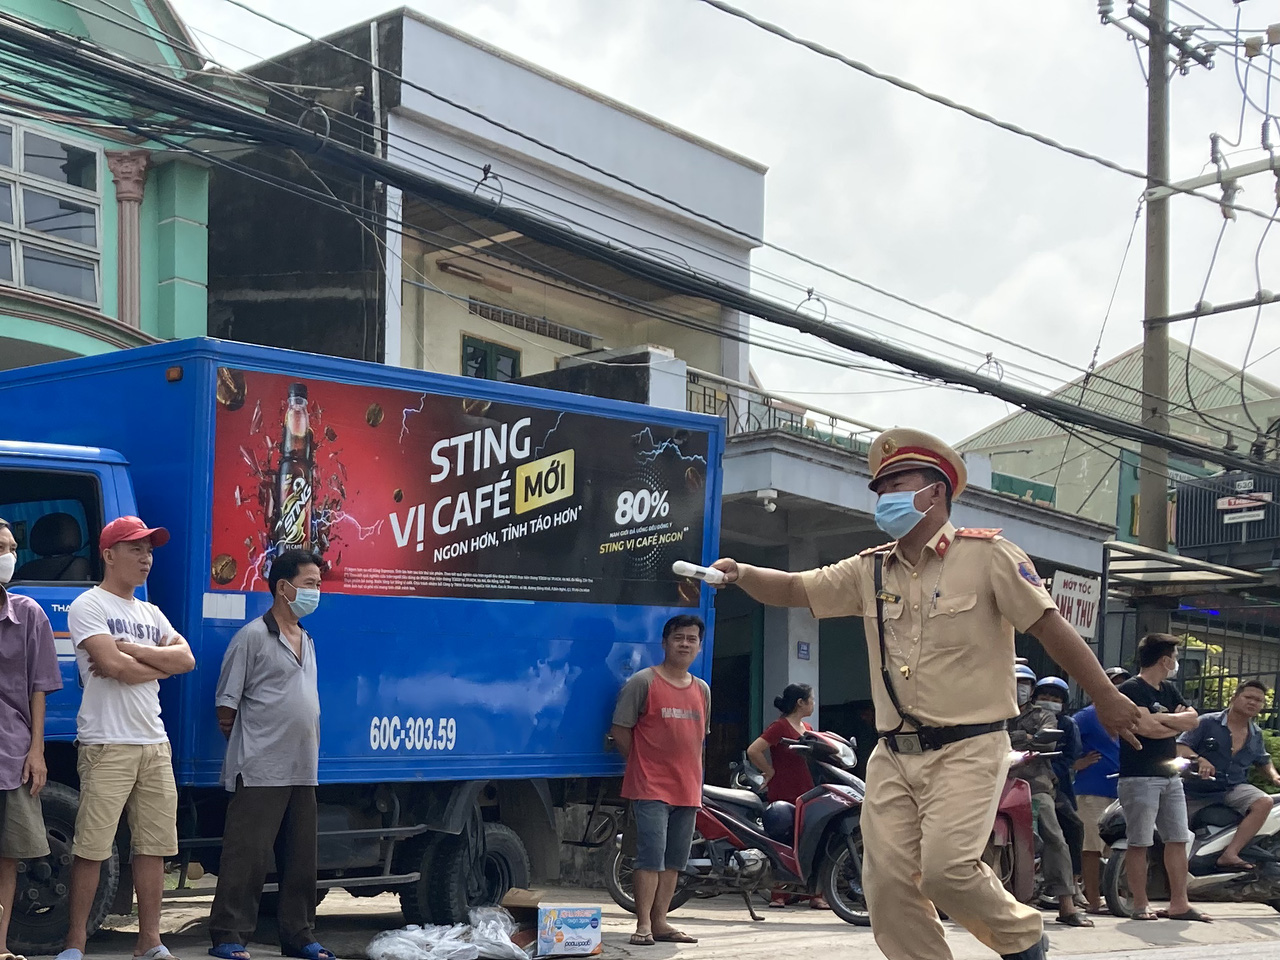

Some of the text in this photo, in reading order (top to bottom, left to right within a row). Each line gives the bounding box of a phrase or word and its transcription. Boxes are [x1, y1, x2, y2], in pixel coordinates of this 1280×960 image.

[430, 417, 532, 483] STING
[284, 484, 312, 533] STING
[389, 459, 566, 552] VỊ CAFÉ MỚI
[615, 489, 670, 525] 80%
[433, 541, 468, 564] NGON
[470, 531, 499, 553] HƠN,
[501, 521, 528, 543] TỈNH
[529, 514, 552, 534] TÁO
[599, 541, 624, 555] STING
[626, 539, 635, 551] VỊ
[636, 533, 658, 548] CAFÉ
[370, 715, 457, 751] 60C-303.59
